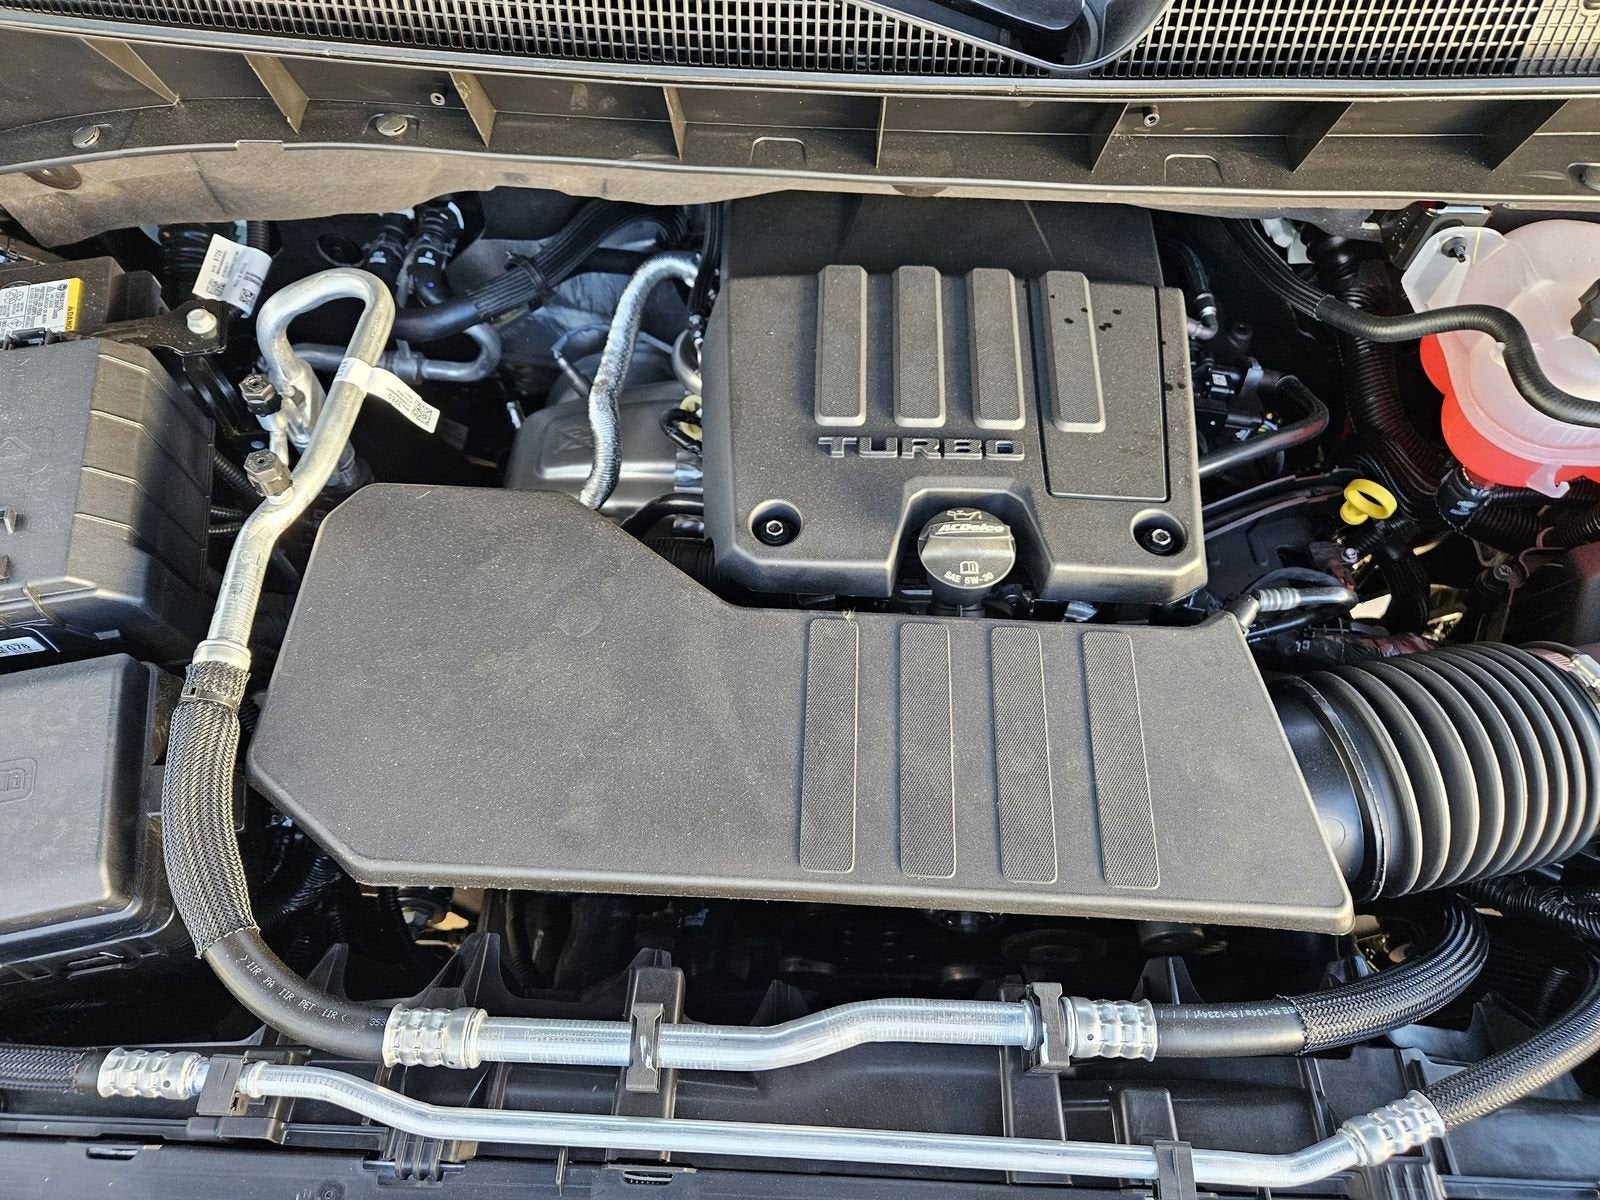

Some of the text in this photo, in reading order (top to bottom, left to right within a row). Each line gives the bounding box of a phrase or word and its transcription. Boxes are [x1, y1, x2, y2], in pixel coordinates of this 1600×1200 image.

[818, 436, 1025, 461] TURBO
[937, 523, 1005, 533] ACDelco
[944, 571, 994, 585] SAE 5W-30
